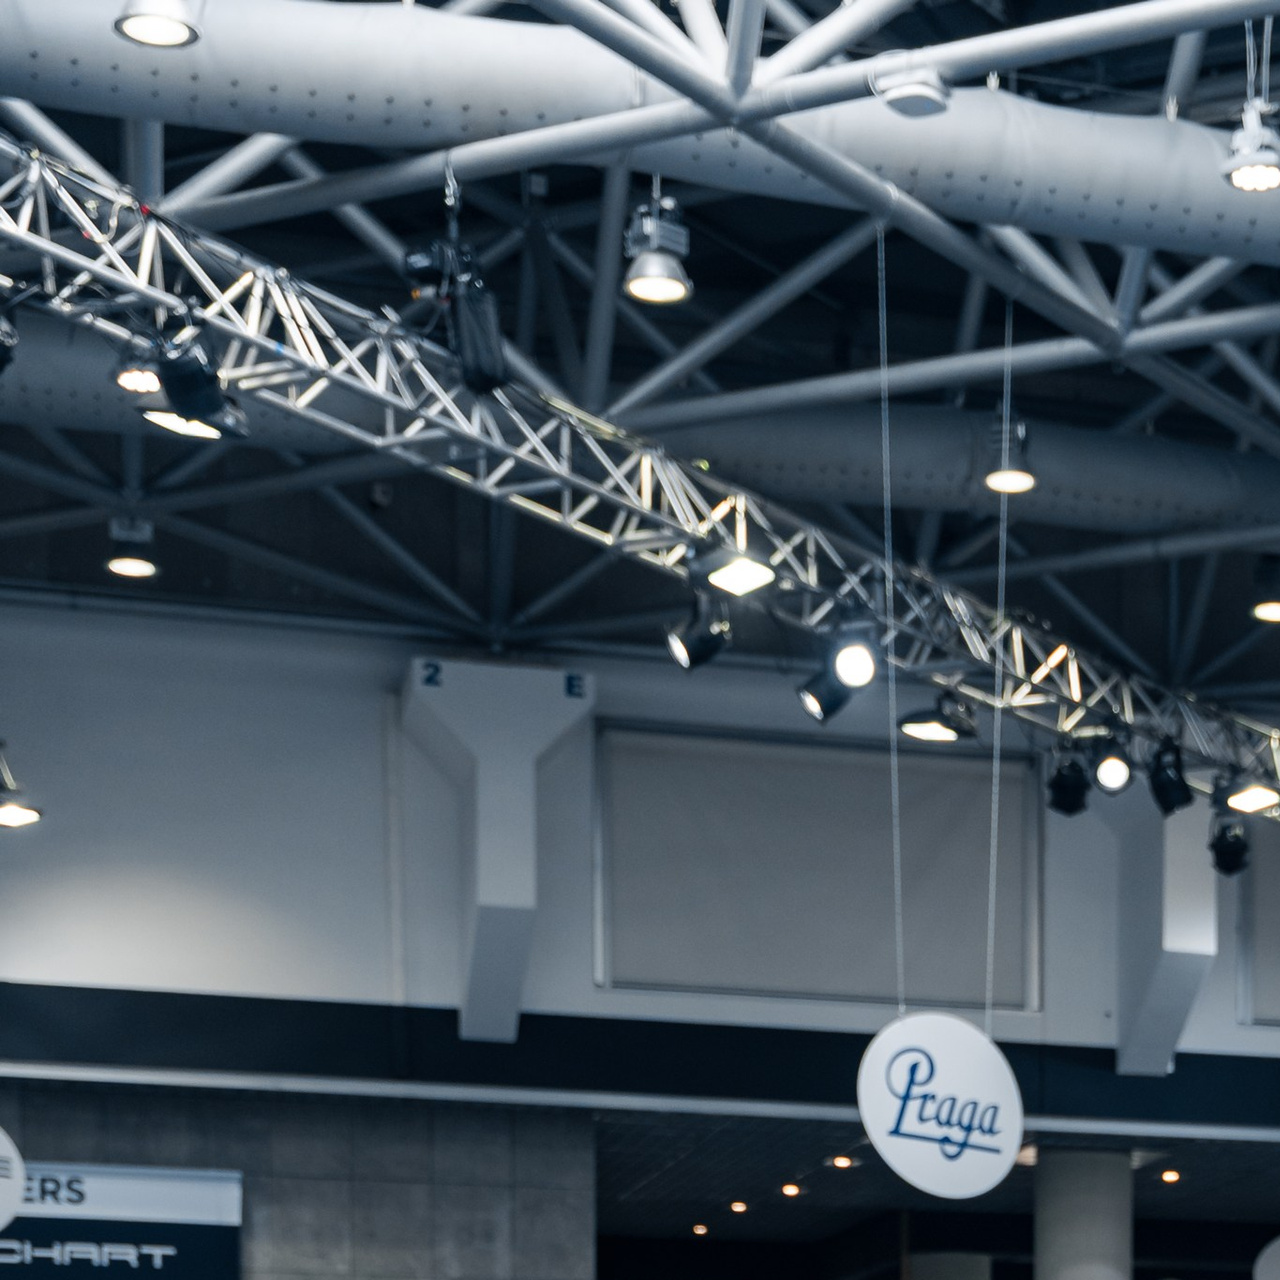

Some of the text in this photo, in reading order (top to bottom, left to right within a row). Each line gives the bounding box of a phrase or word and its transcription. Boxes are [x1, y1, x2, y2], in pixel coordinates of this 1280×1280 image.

[422, 662, 442, 687] 2
[564, 674, 585, 698] E
[886, 1048, 1002, 1161] Praga
